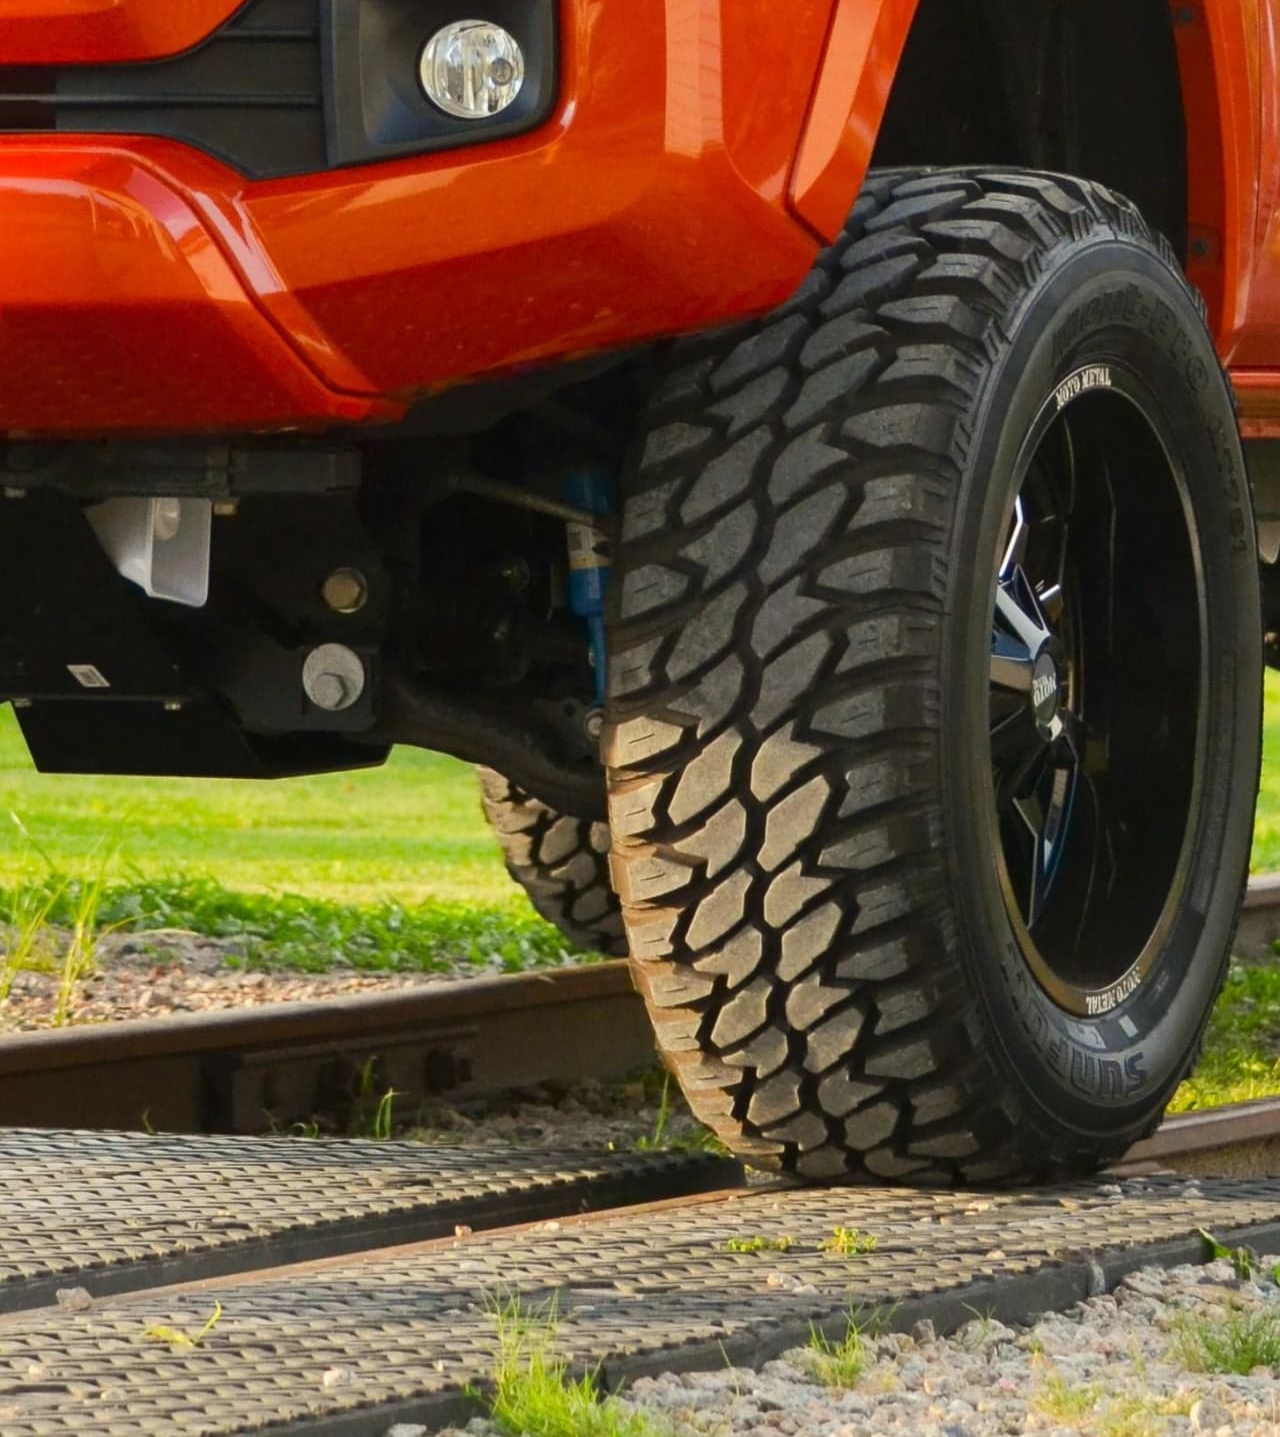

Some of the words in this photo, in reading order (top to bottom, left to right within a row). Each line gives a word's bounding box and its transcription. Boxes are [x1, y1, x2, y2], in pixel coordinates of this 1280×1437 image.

[1055, 375, 1081, 411] MOTO
[1081, 366, 1112, 390] METAL
[1086, 990, 1116, 1015] METAL
[1116, 966, 1141, 1003] MOTO
